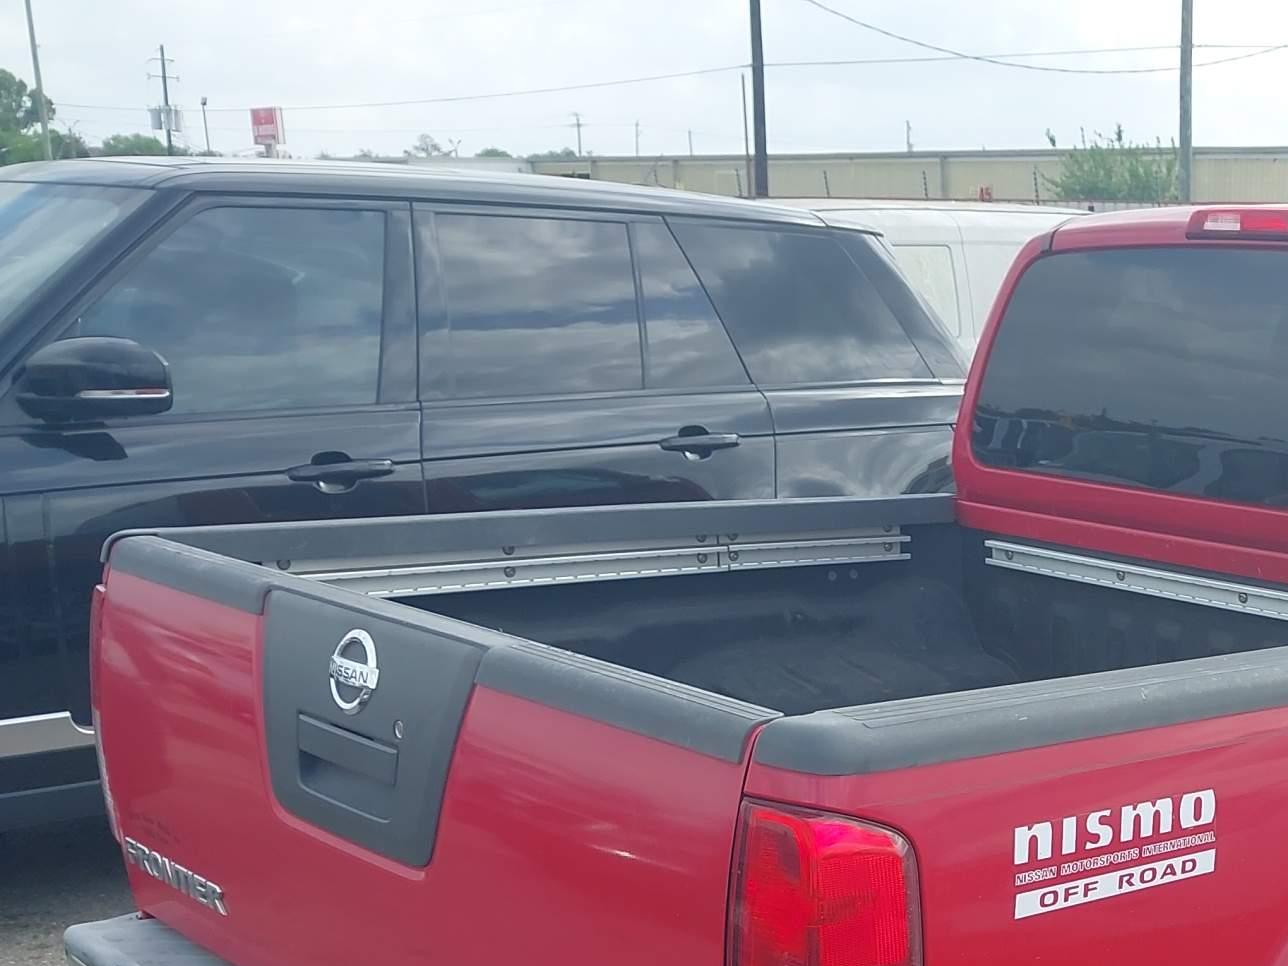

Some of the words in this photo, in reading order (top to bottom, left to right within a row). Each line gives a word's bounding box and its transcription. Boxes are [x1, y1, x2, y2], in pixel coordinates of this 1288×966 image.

[329, 660, 369, 684] NISSAN
[1013, 787, 1217, 866] nismo
[125, 836, 228, 916] FRONTIER
[1014, 866, 1058, 887] NISSAN
[1060, 848, 1140, 876] MOTORSPORTS
[1141, 830, 1217, 857] INTERNATIONAL
[1038, 879, 1100, 909] OFF
[1116, 857, 1198, 890] ROAD
